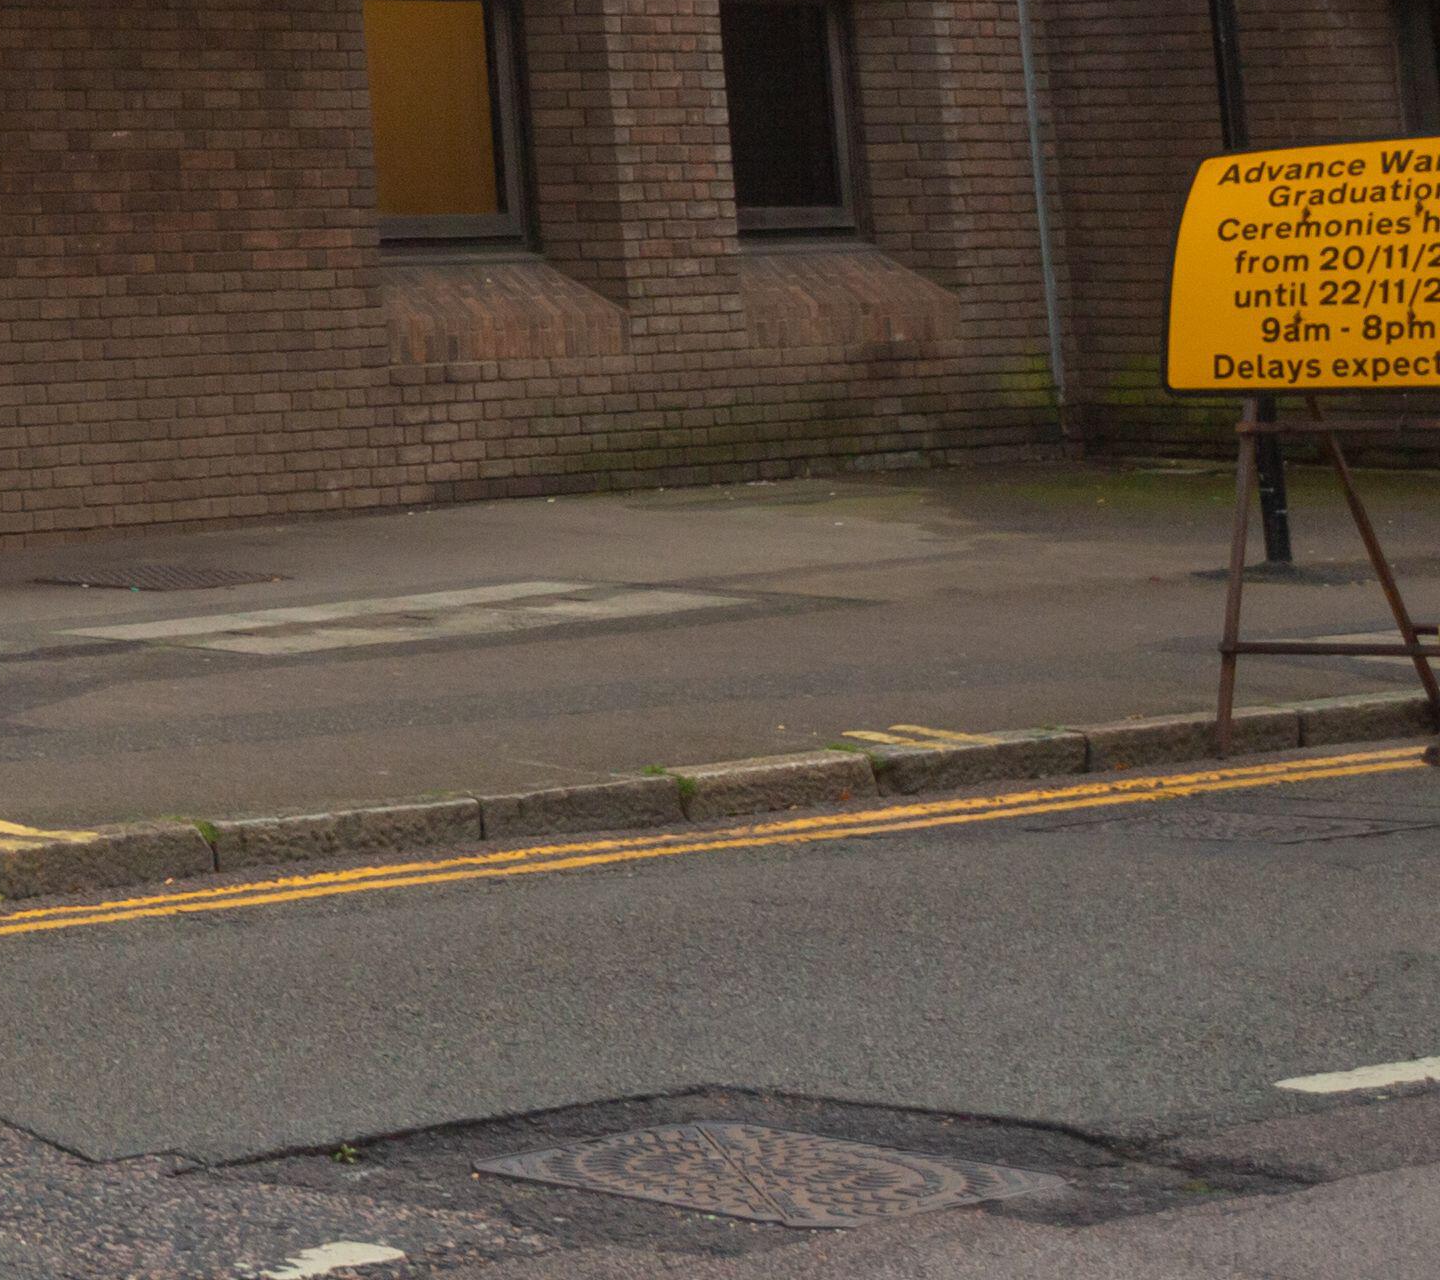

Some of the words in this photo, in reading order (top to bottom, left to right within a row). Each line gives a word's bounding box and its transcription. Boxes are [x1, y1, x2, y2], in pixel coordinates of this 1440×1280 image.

[1217, 157, 1366, 186] Advance
[1217, 212, 1411, 242] Ceremonies
[1234, 250, 1310, 275] from
[1234, 282, 1308, 309] until
[1261, 316, 1331, 343] 9am
[1361, 313, 1436, 345] 8pm
[1213, 354, 1322, 384] Delays
